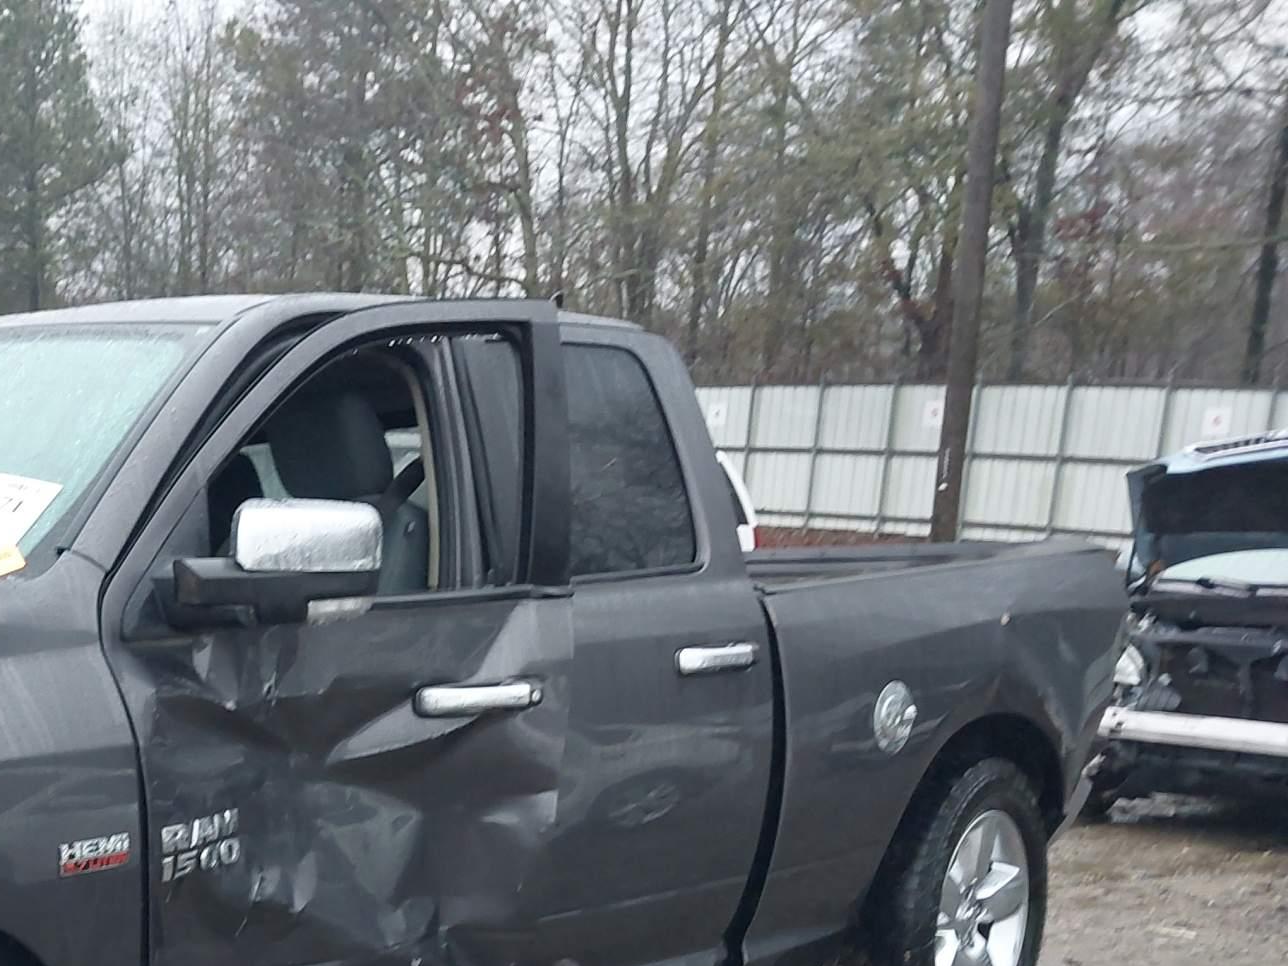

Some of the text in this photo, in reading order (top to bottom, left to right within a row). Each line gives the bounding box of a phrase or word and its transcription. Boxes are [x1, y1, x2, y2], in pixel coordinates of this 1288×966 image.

[58, 832, 130, 866] HEMI
[161, 808, 240, 854] RAM
[161, 837, 241, 883] 1500
